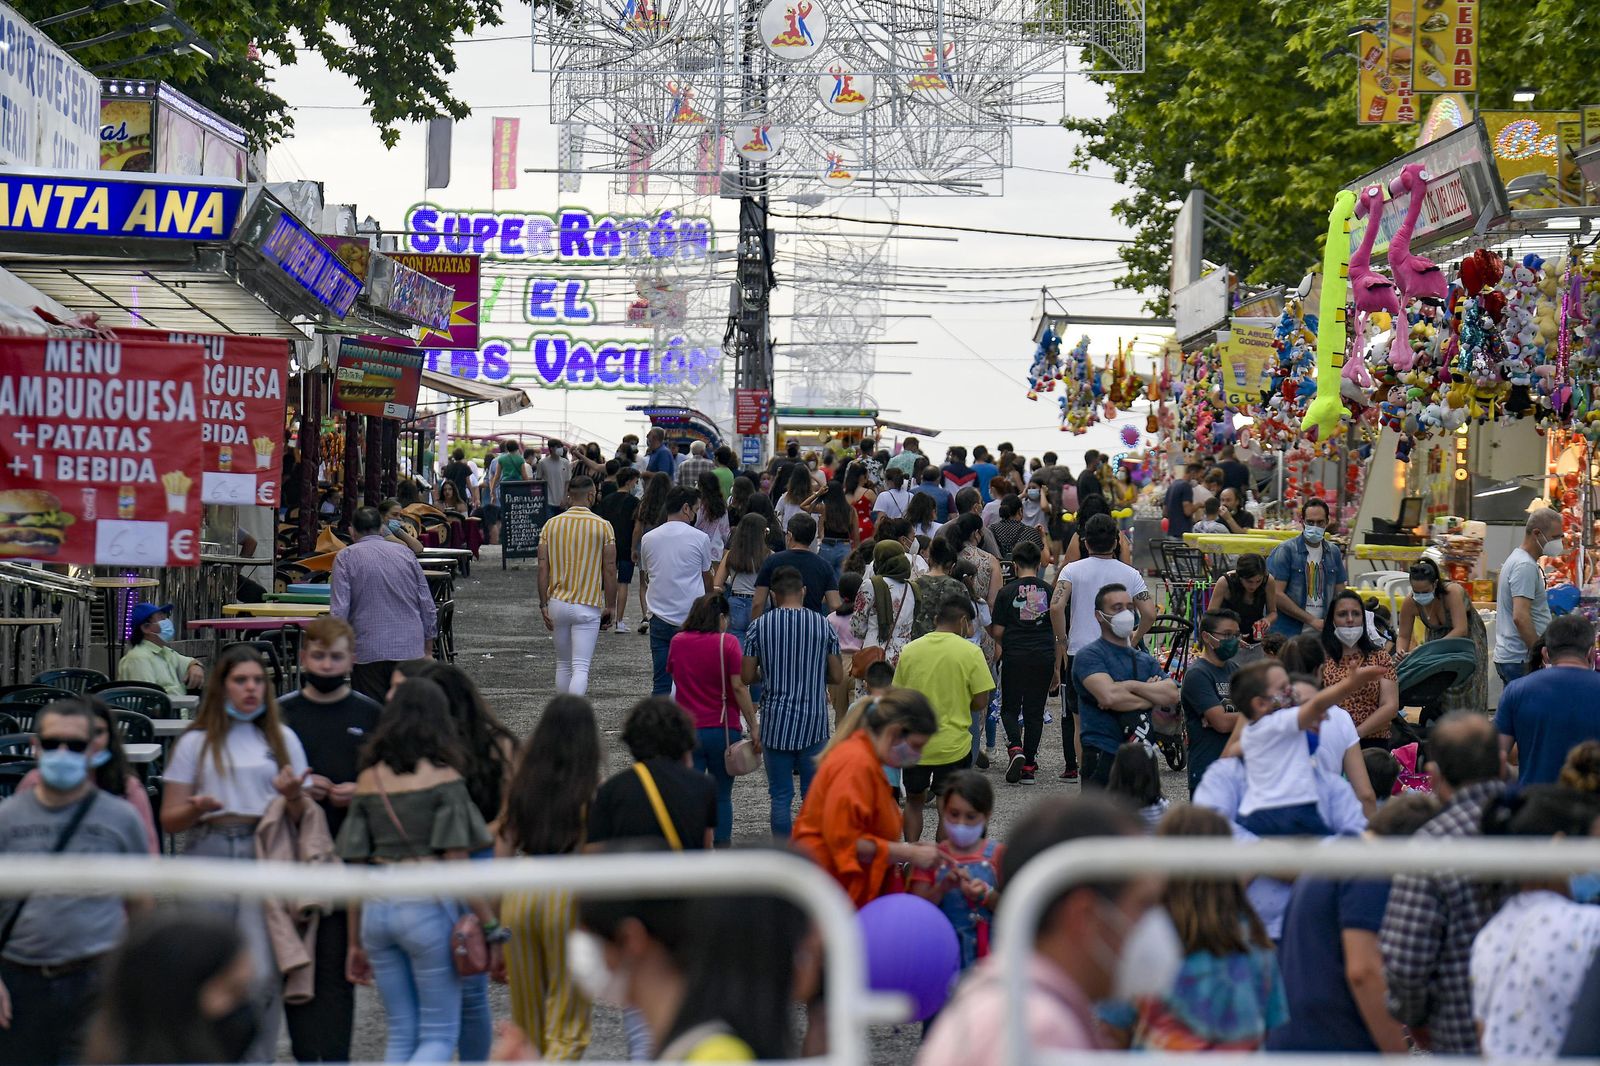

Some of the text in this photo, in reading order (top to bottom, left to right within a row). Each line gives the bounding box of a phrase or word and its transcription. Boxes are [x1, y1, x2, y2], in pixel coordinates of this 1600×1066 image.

[1454, 0, 1474, 86] EBAB
[122, 188, 224, 235] ANA
[409, 208, 553, 254] SUPER
[425, 256, 471, 273] PATATAS
[530, 280, 591, 318] EL
[45, 341, 122, 375] MENU
[57, 456, 157, 483] BEBIDA
